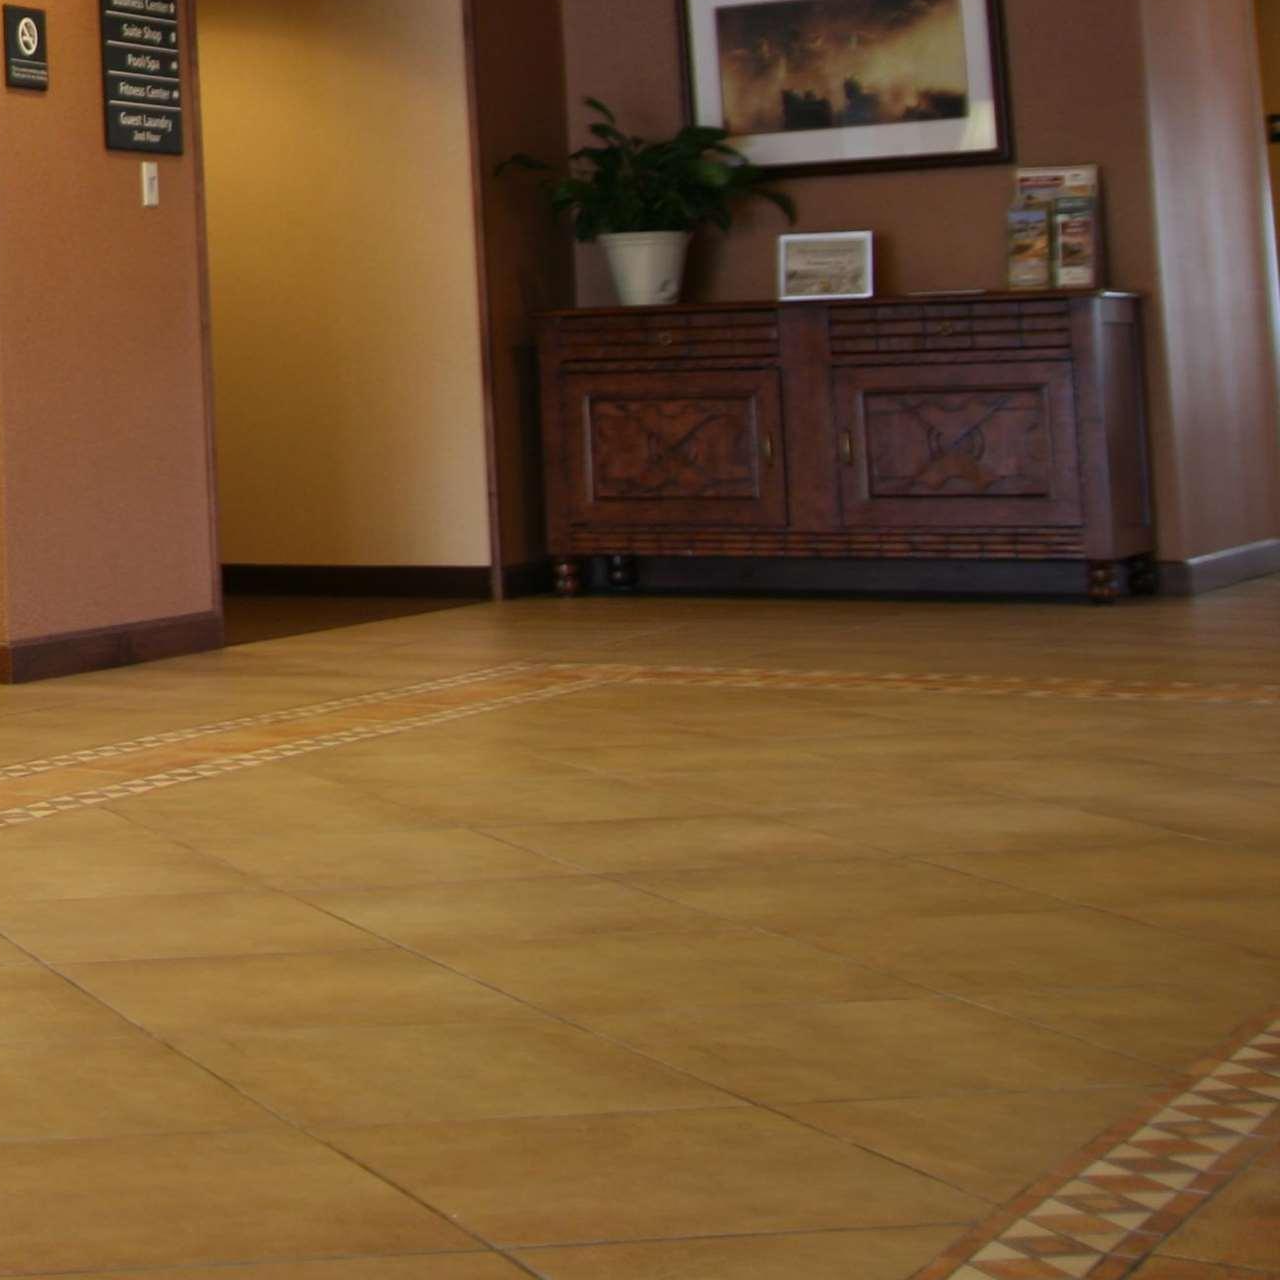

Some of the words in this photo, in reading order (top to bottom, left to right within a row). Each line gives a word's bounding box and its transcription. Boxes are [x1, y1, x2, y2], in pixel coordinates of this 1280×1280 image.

[119, 81, 145, 97] Fitness
[146, 85, 170, 100] Center
[119, 111, 142, 126] Guest
[143, 114, 173, 133] Laundry
